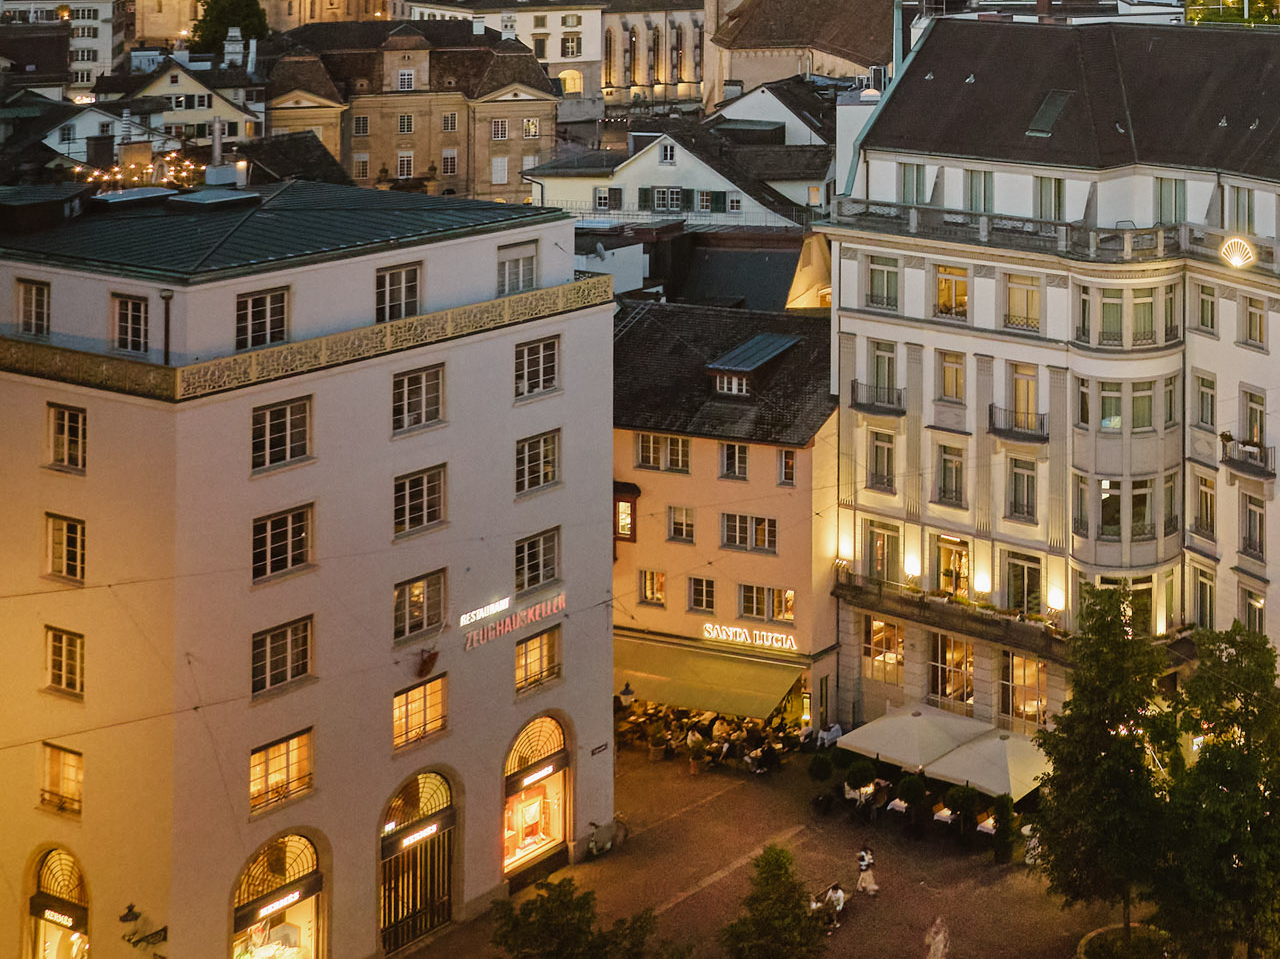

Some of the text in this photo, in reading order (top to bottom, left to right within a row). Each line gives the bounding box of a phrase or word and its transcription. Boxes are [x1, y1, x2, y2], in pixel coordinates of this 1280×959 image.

[460, 597, 510, 627] RESTAURANT
[464, 592, 566, 651] ZEUGHAUSKELLER
[703, 623, 798, 650] SANTA LUCIA
